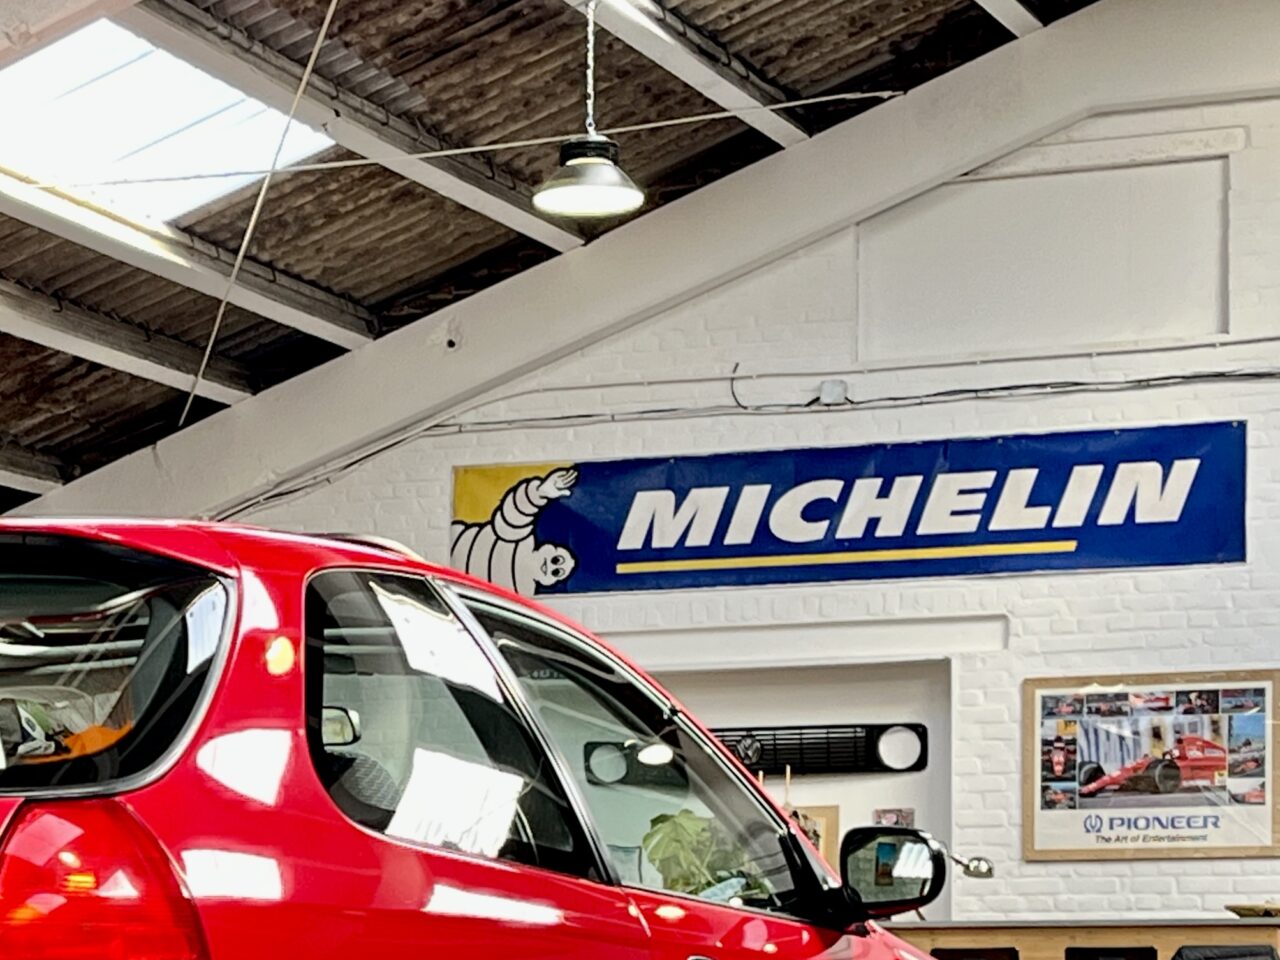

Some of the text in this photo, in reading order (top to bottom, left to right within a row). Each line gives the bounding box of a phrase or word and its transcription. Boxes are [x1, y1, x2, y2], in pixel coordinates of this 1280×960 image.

[616, 458, 1201, 551] MICHELIN
[1108, 815, 1221, 831] PIONEER
[1095, 833, 1209, 844] The Art of Entertainment
